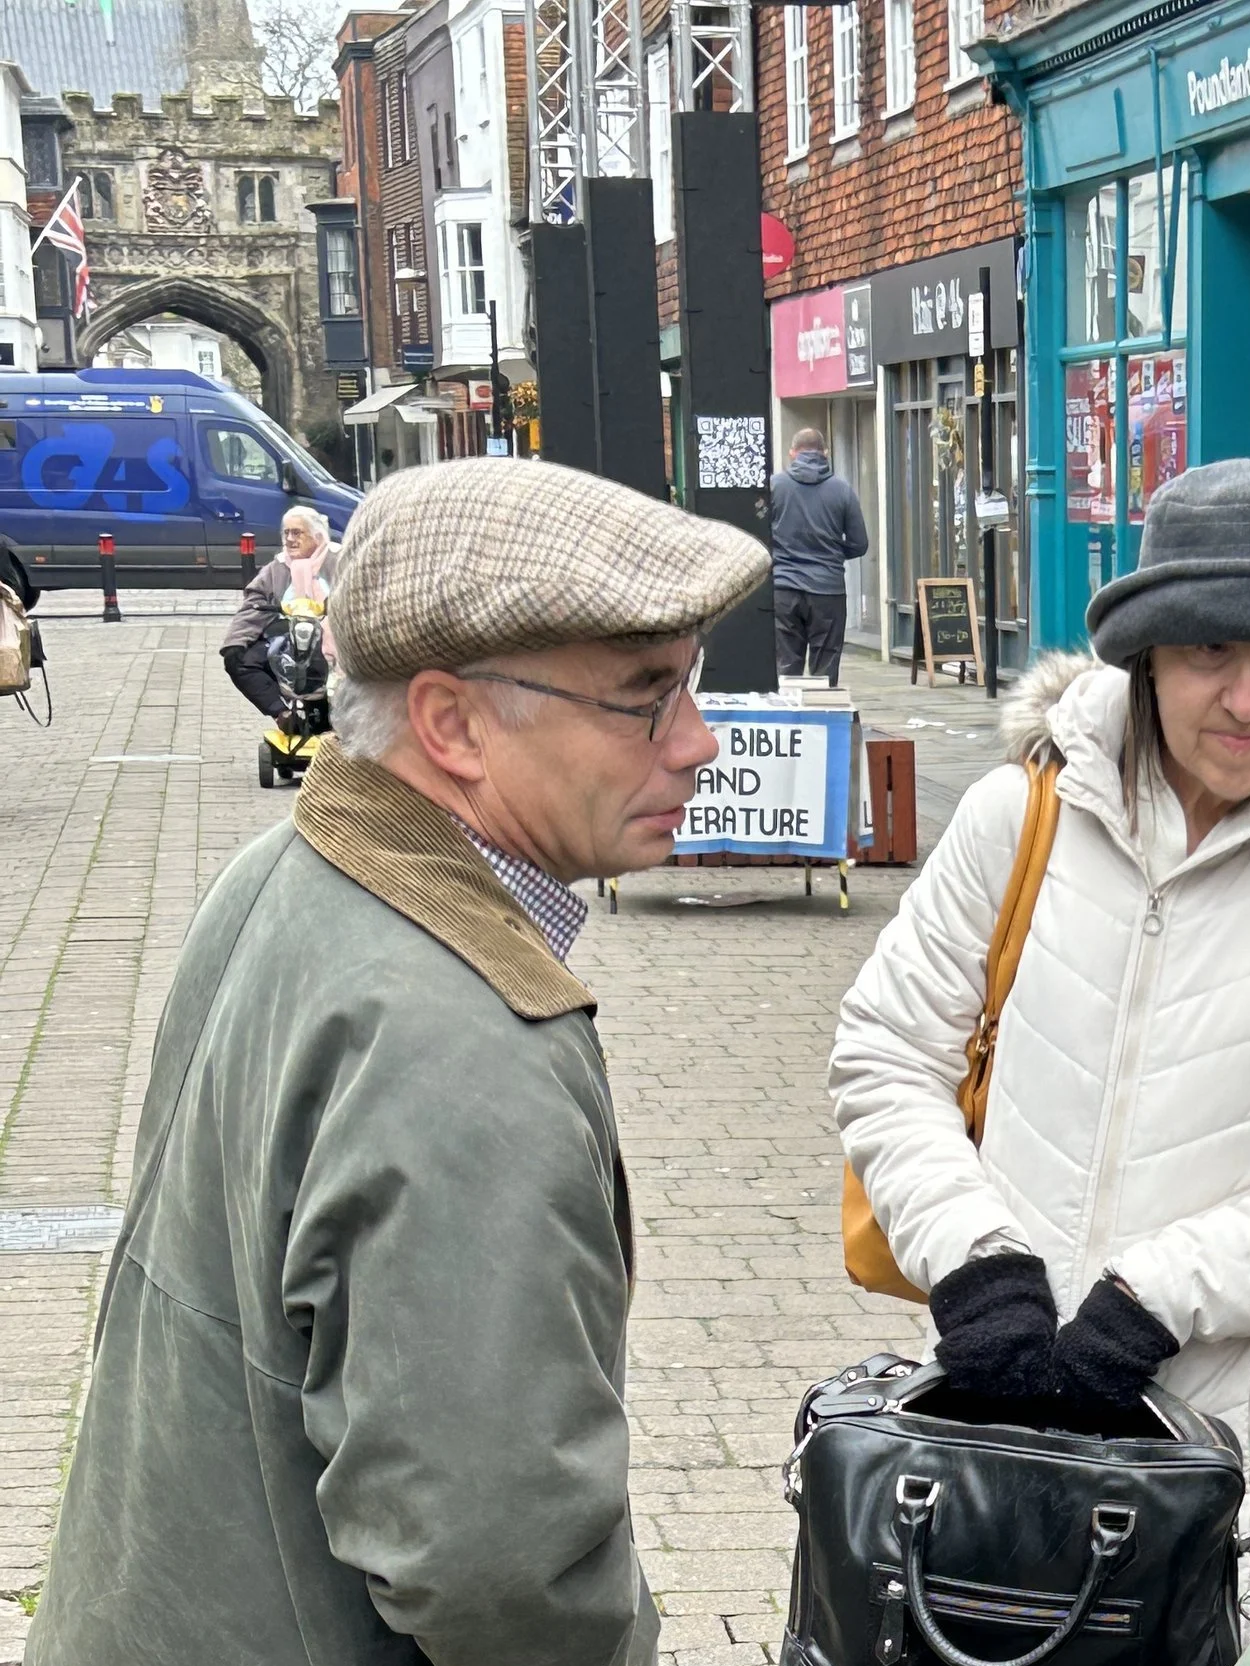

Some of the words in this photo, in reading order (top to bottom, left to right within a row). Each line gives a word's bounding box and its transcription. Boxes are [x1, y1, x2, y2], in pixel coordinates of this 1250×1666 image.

[731, 727, 802, 758] BIBLE
[696, 766, 762, 797] AND
[676, 805, 809, 837] ERATURE
